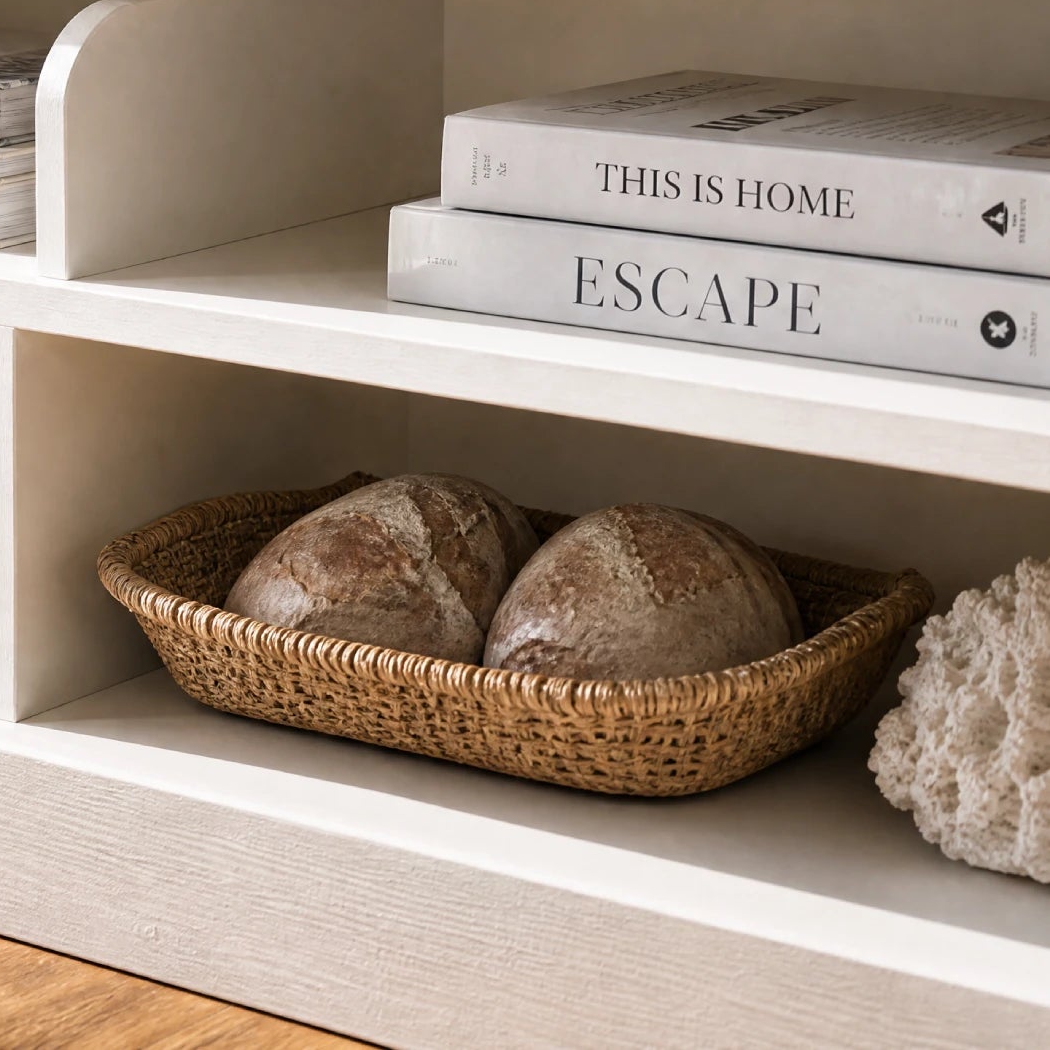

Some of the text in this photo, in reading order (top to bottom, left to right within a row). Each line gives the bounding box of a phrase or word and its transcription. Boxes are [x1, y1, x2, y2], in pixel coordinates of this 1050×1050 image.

[595, 162, 856, 219] THIS IS HOME
[572, 255, 822, 335] ESCAPE
